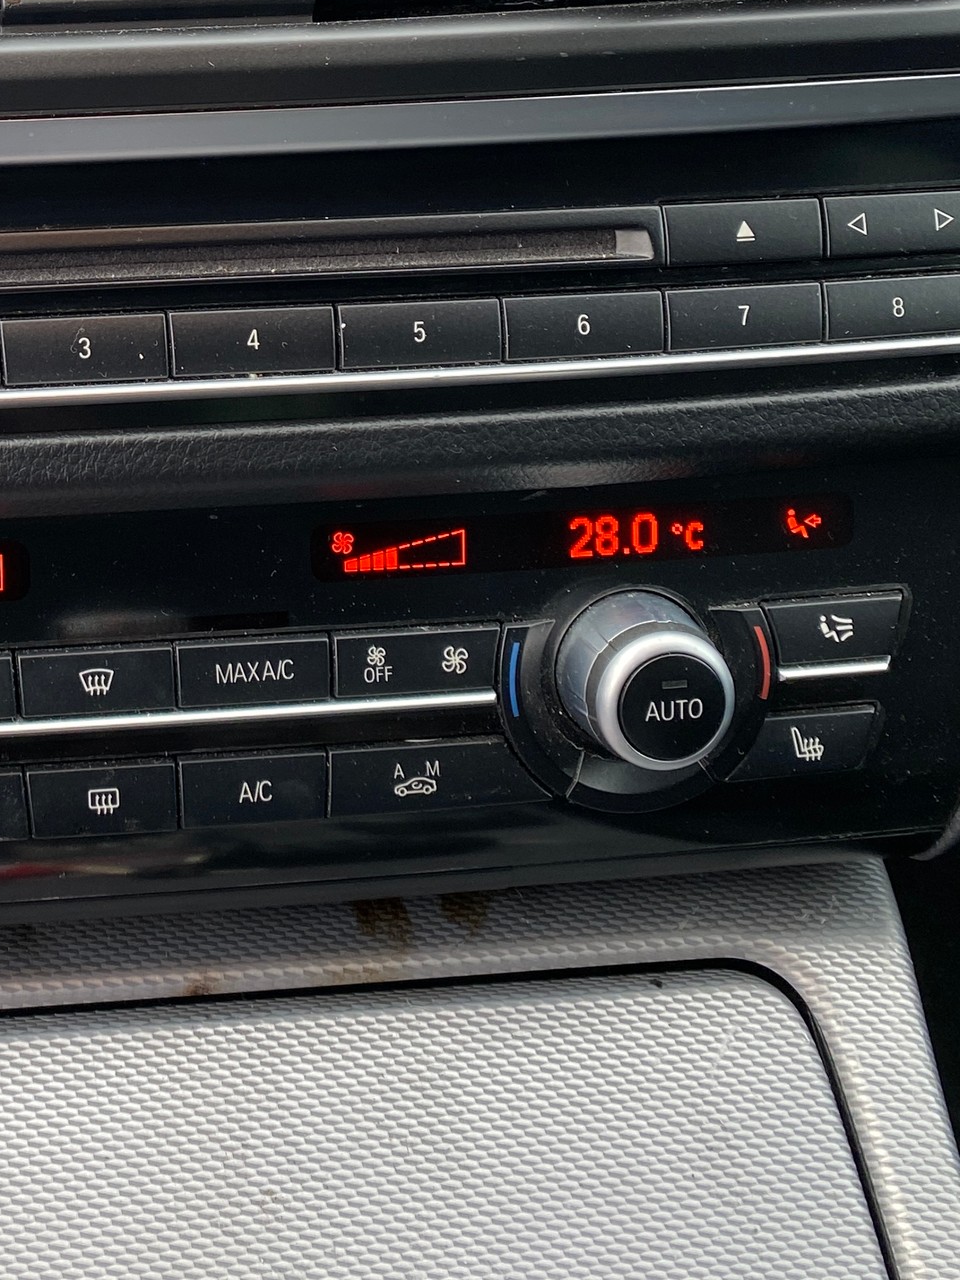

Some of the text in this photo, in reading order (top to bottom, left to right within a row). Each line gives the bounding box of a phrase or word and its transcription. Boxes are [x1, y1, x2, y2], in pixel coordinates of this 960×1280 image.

[737, 304, 751, 327] 7
[890, 296, 906, 319] 8
[413, 320, 427, 343] 5
[576, 313, 591, 336] 6
[77, 336, 93, 360] 3
[246, 328, 261, 352] 4
[568, 514, 659, 559] 28.0
[262, 658, 295, 683] A/C
[363, 666, 393, 685] OFF
[645, 697, 705, 723] AUTO
[393, 762, 440, 780] A M
[239, 780, 273, 804] A/C
